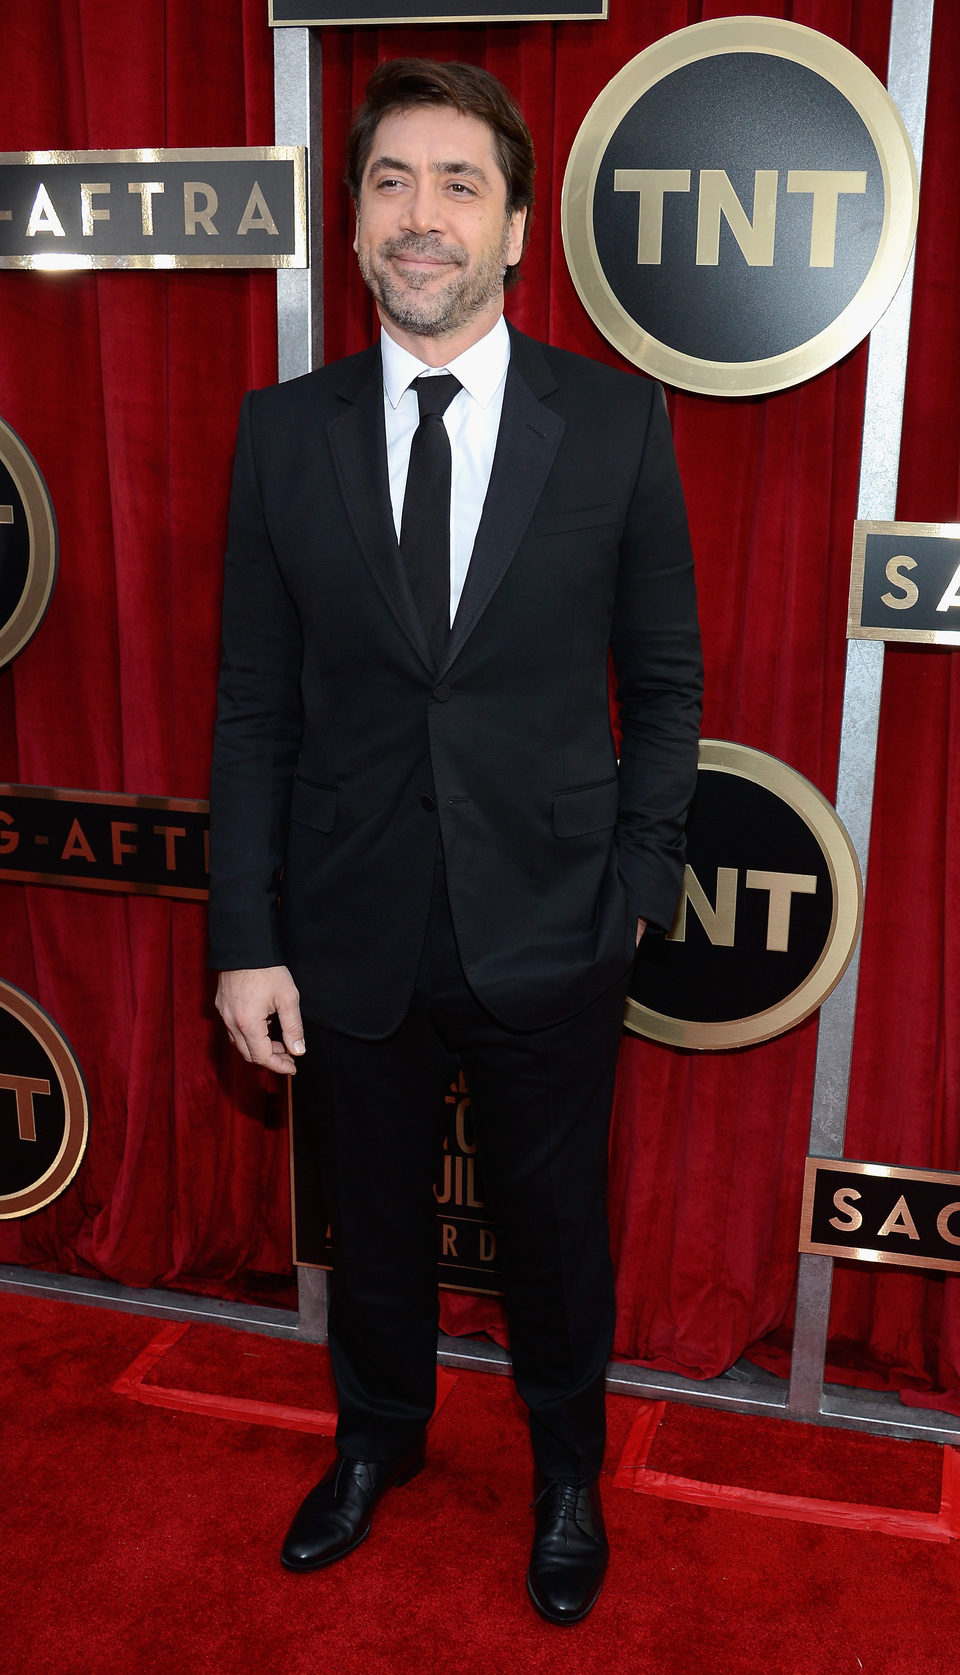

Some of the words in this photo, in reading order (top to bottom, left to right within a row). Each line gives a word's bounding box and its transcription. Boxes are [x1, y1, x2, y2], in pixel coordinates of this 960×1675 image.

[613, 169, 868, 268] TNT
[0, 810, 210, 875] G-AFT
[664, 864, 817, 953] NT
